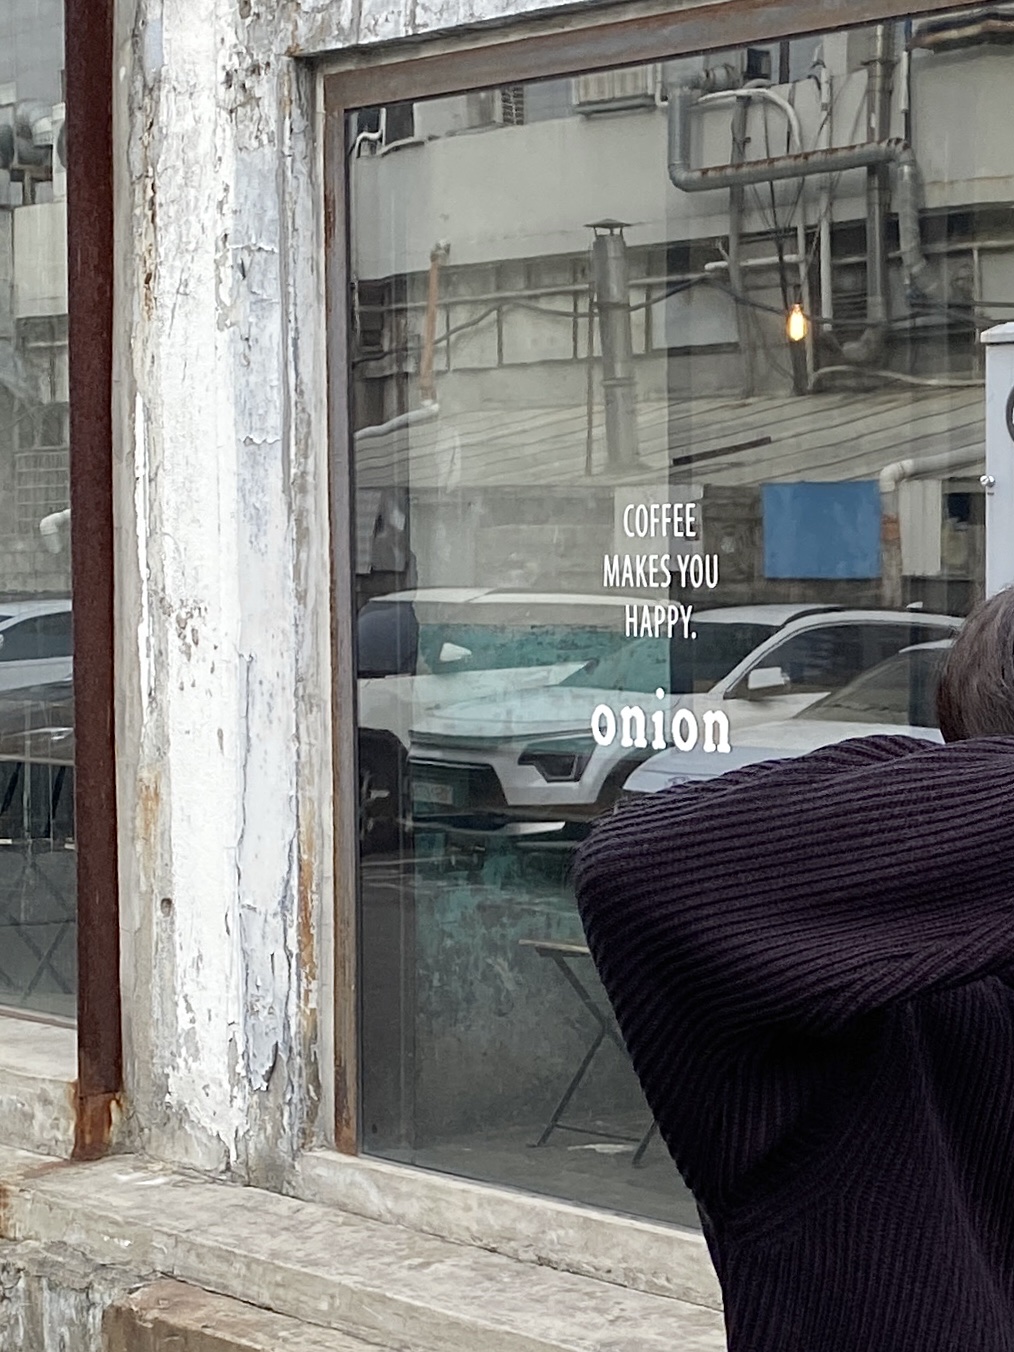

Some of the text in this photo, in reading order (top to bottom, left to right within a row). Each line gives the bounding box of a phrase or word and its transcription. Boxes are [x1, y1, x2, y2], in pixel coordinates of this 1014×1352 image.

[623, 502, 697, 538] COFFEE
[603, 553, 719, 589] MAKES YOU
[624, 604, 697, 640] HAPPY.
[590, 687, 732, 753] onion
